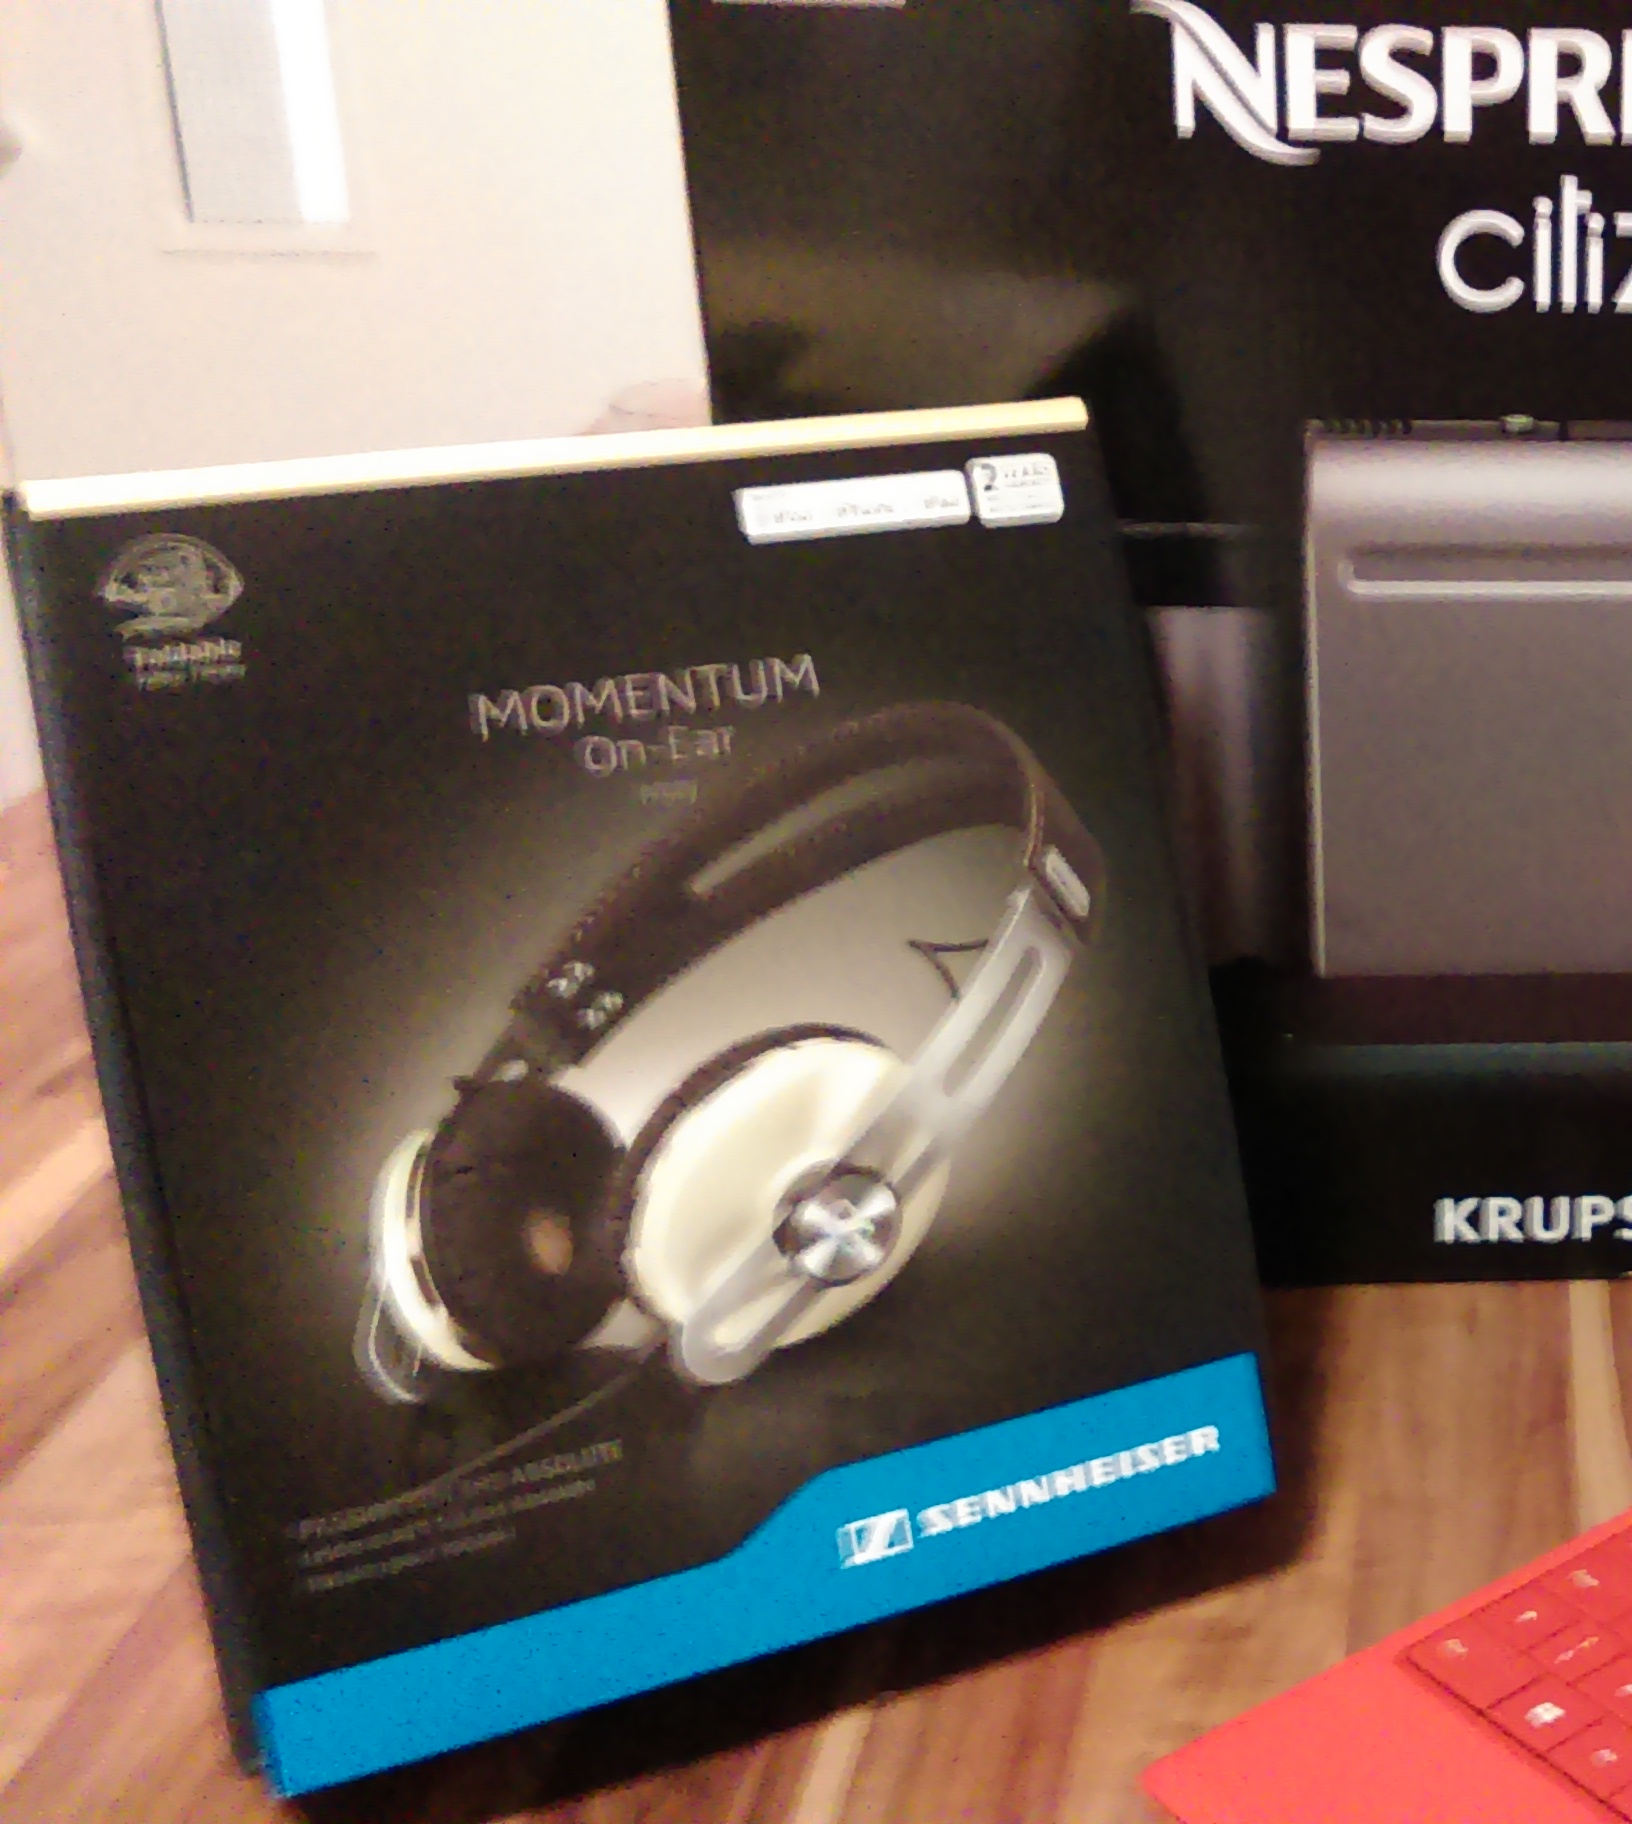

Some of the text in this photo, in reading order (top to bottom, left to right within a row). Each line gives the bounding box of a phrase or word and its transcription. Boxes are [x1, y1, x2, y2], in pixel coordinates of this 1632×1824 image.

[468, 654, 821, 742] MOMENTUM
[575, 725, 734, 777] On-Ear
[916, 1425, 1220, 1538] SENNHEISER
